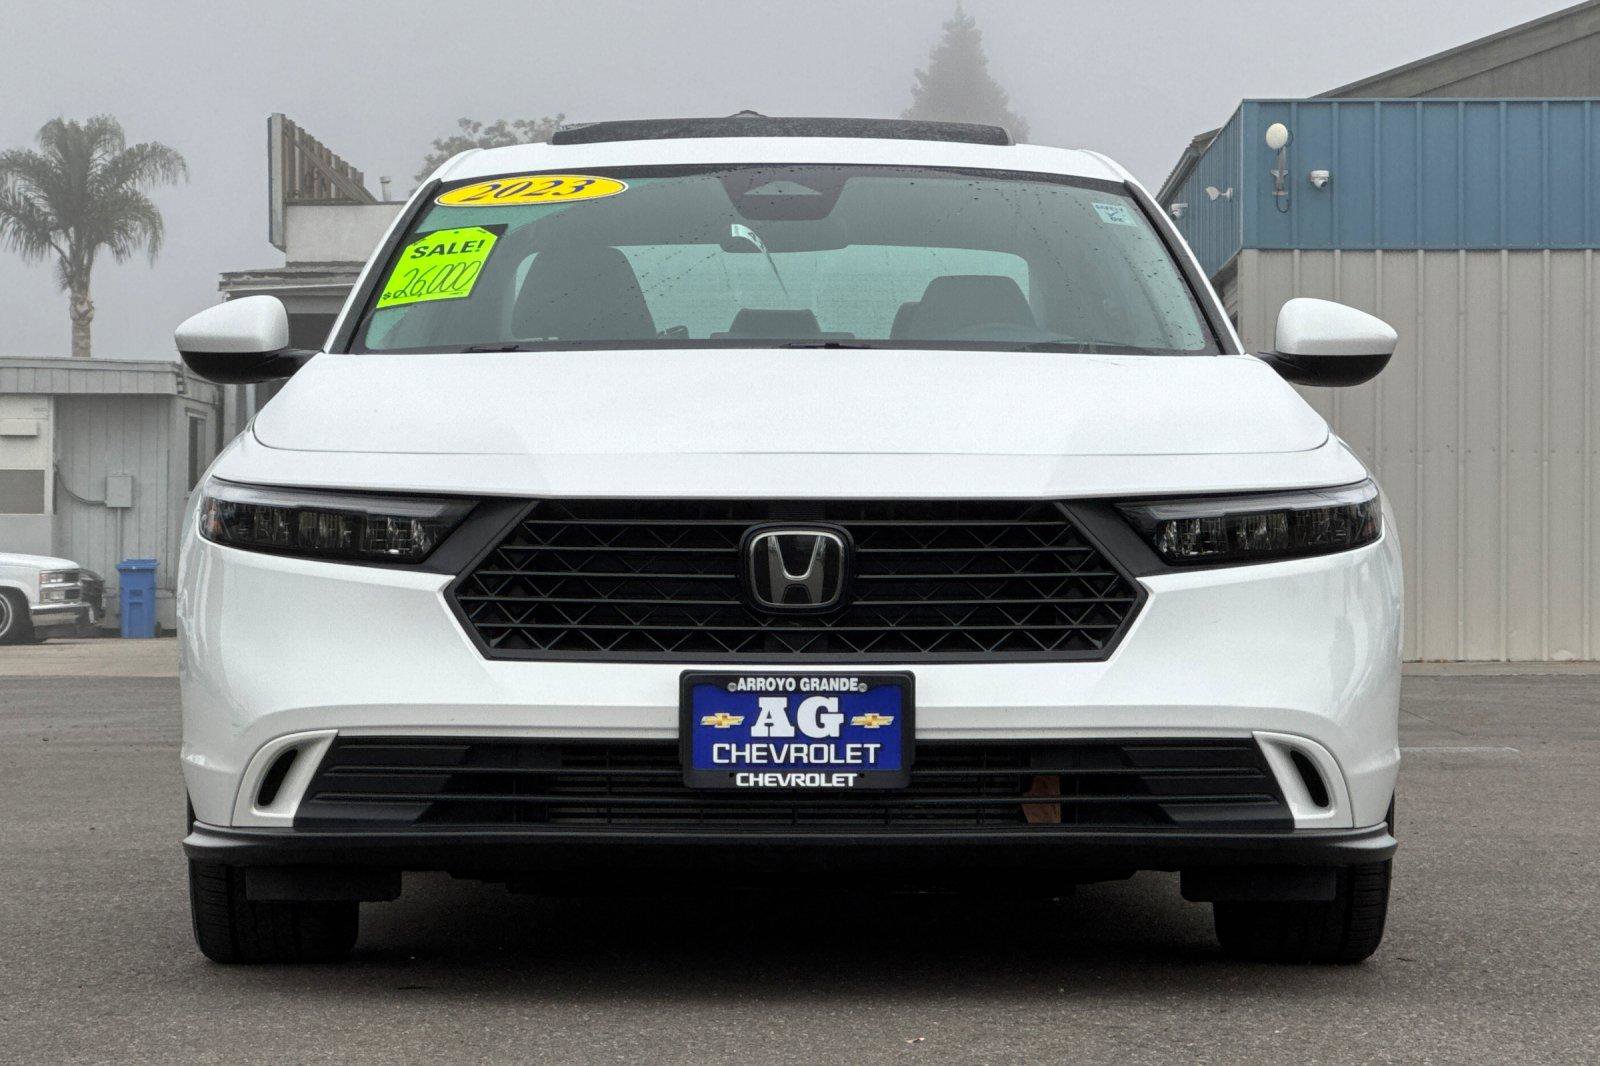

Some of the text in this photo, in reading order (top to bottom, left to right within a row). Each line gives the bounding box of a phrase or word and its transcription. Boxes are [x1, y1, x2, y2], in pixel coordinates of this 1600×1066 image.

[458, 179, 596, 203] 2023
[410, 239, 486, 260] SALE!
[737, 677, 859, 692] ARROYO GRANDE
[751, 696, 845, 739] AG
[712, 743, 881, 764] CHEVROLET
[735, 772, 858, 787] CHEVROLET
